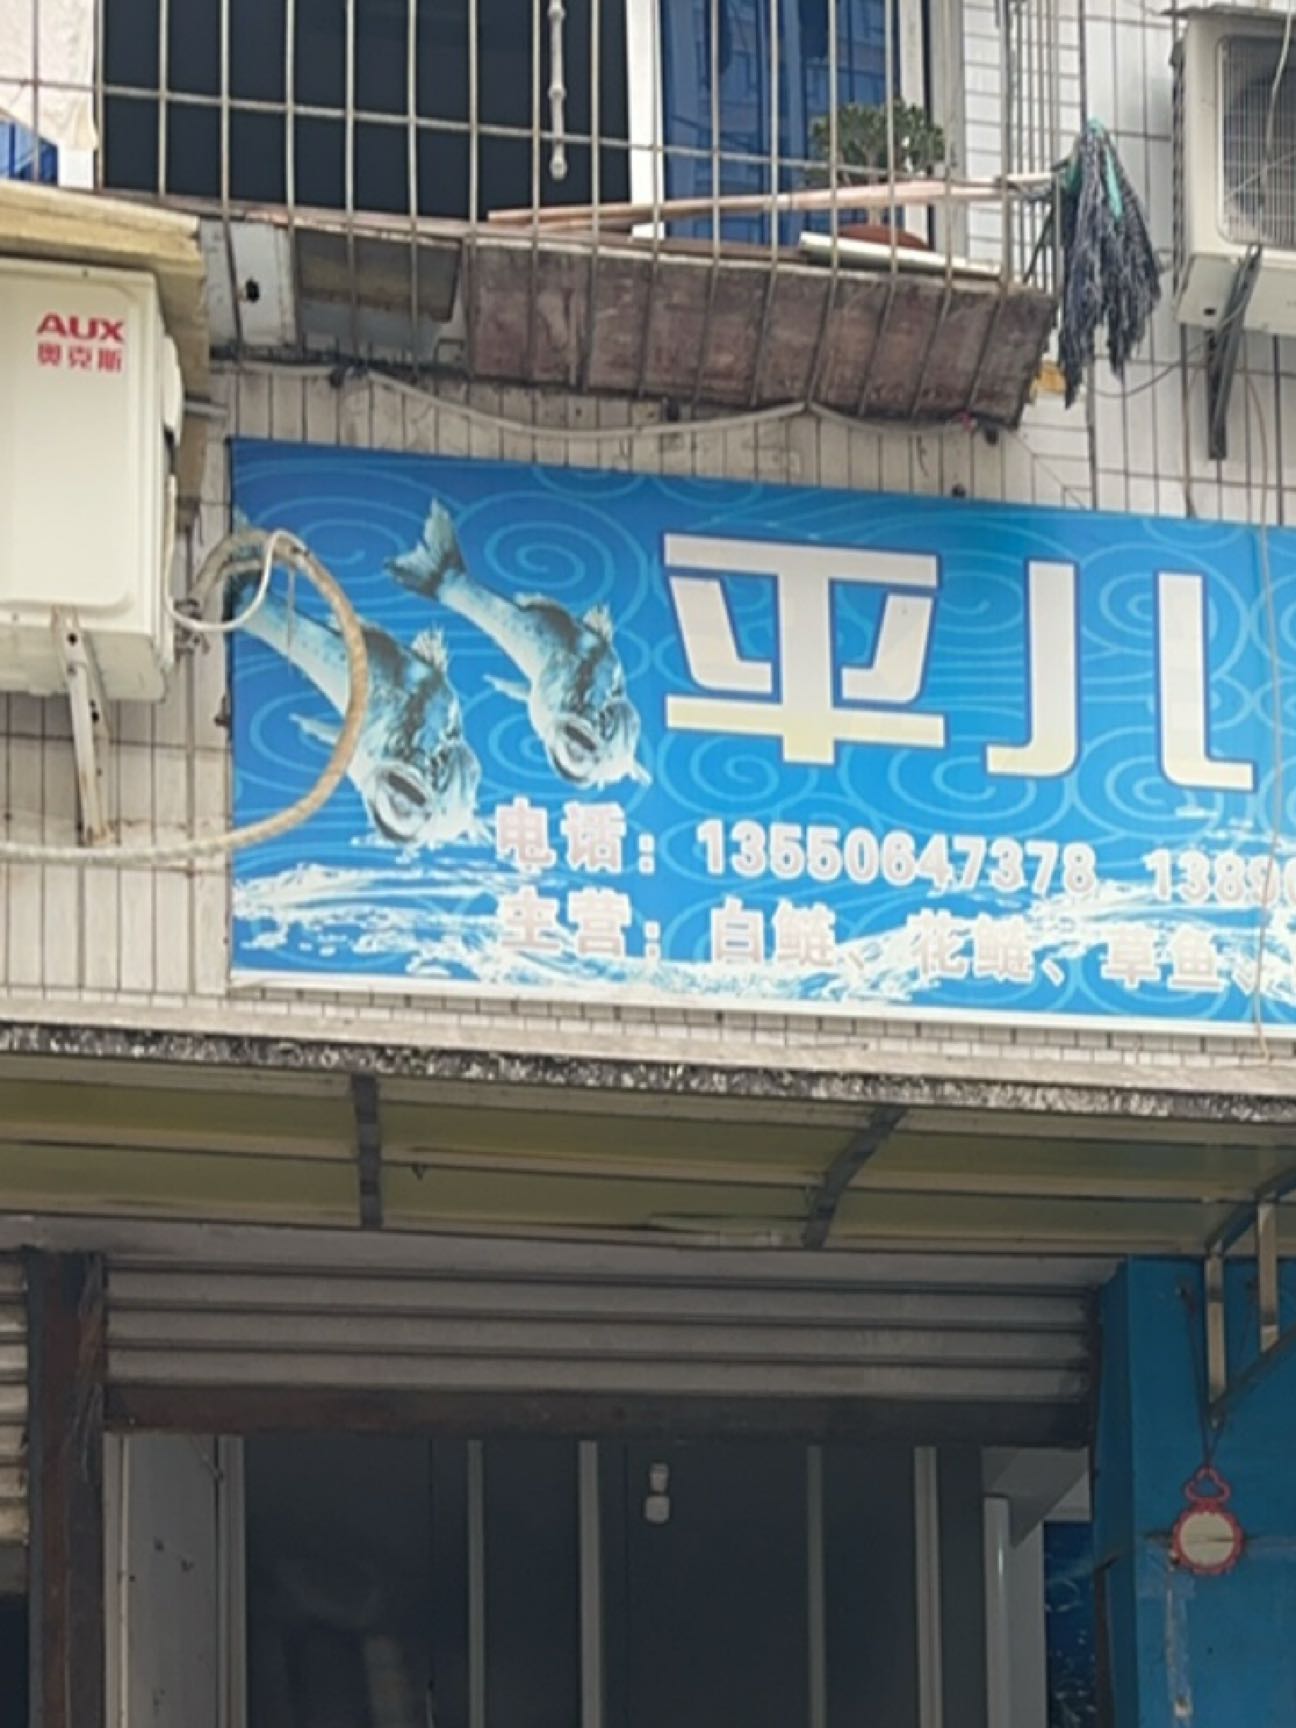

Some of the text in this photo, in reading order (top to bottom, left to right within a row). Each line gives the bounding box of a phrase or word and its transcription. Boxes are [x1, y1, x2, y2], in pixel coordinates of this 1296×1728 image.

[37, 312, 124, 342] AUX
[37, 343, 122, 373] 奥克斯
